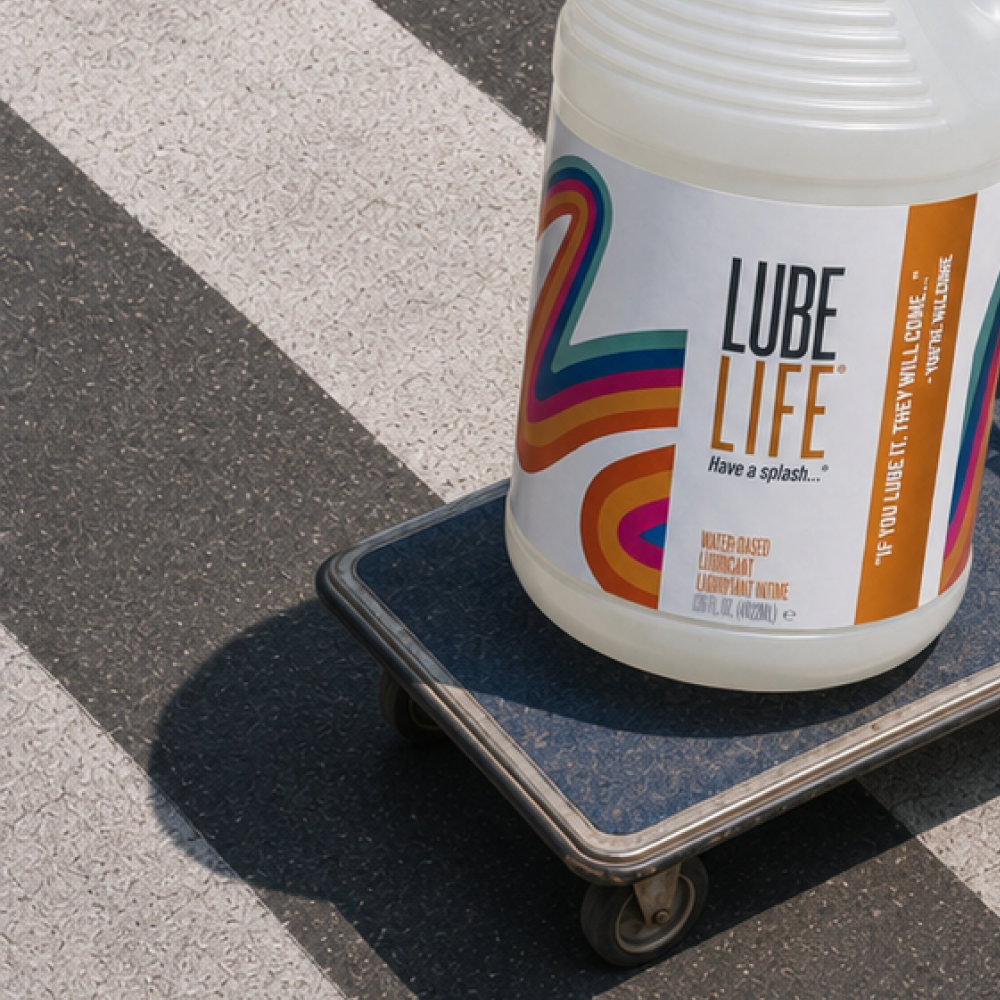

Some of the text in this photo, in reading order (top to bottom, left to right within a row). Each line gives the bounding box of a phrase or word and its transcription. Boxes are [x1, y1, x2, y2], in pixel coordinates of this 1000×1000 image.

[722, 256, 846, 360] LUBE
[899, 343, 919, 388] WILL
[892, 390, 914, 435] THEY
[708, 455, 744, 477] Have
[746, 464, 757, 479] a
[884, 459, 905, 502] LUBE
[878, 505, 898, 538] YOU
